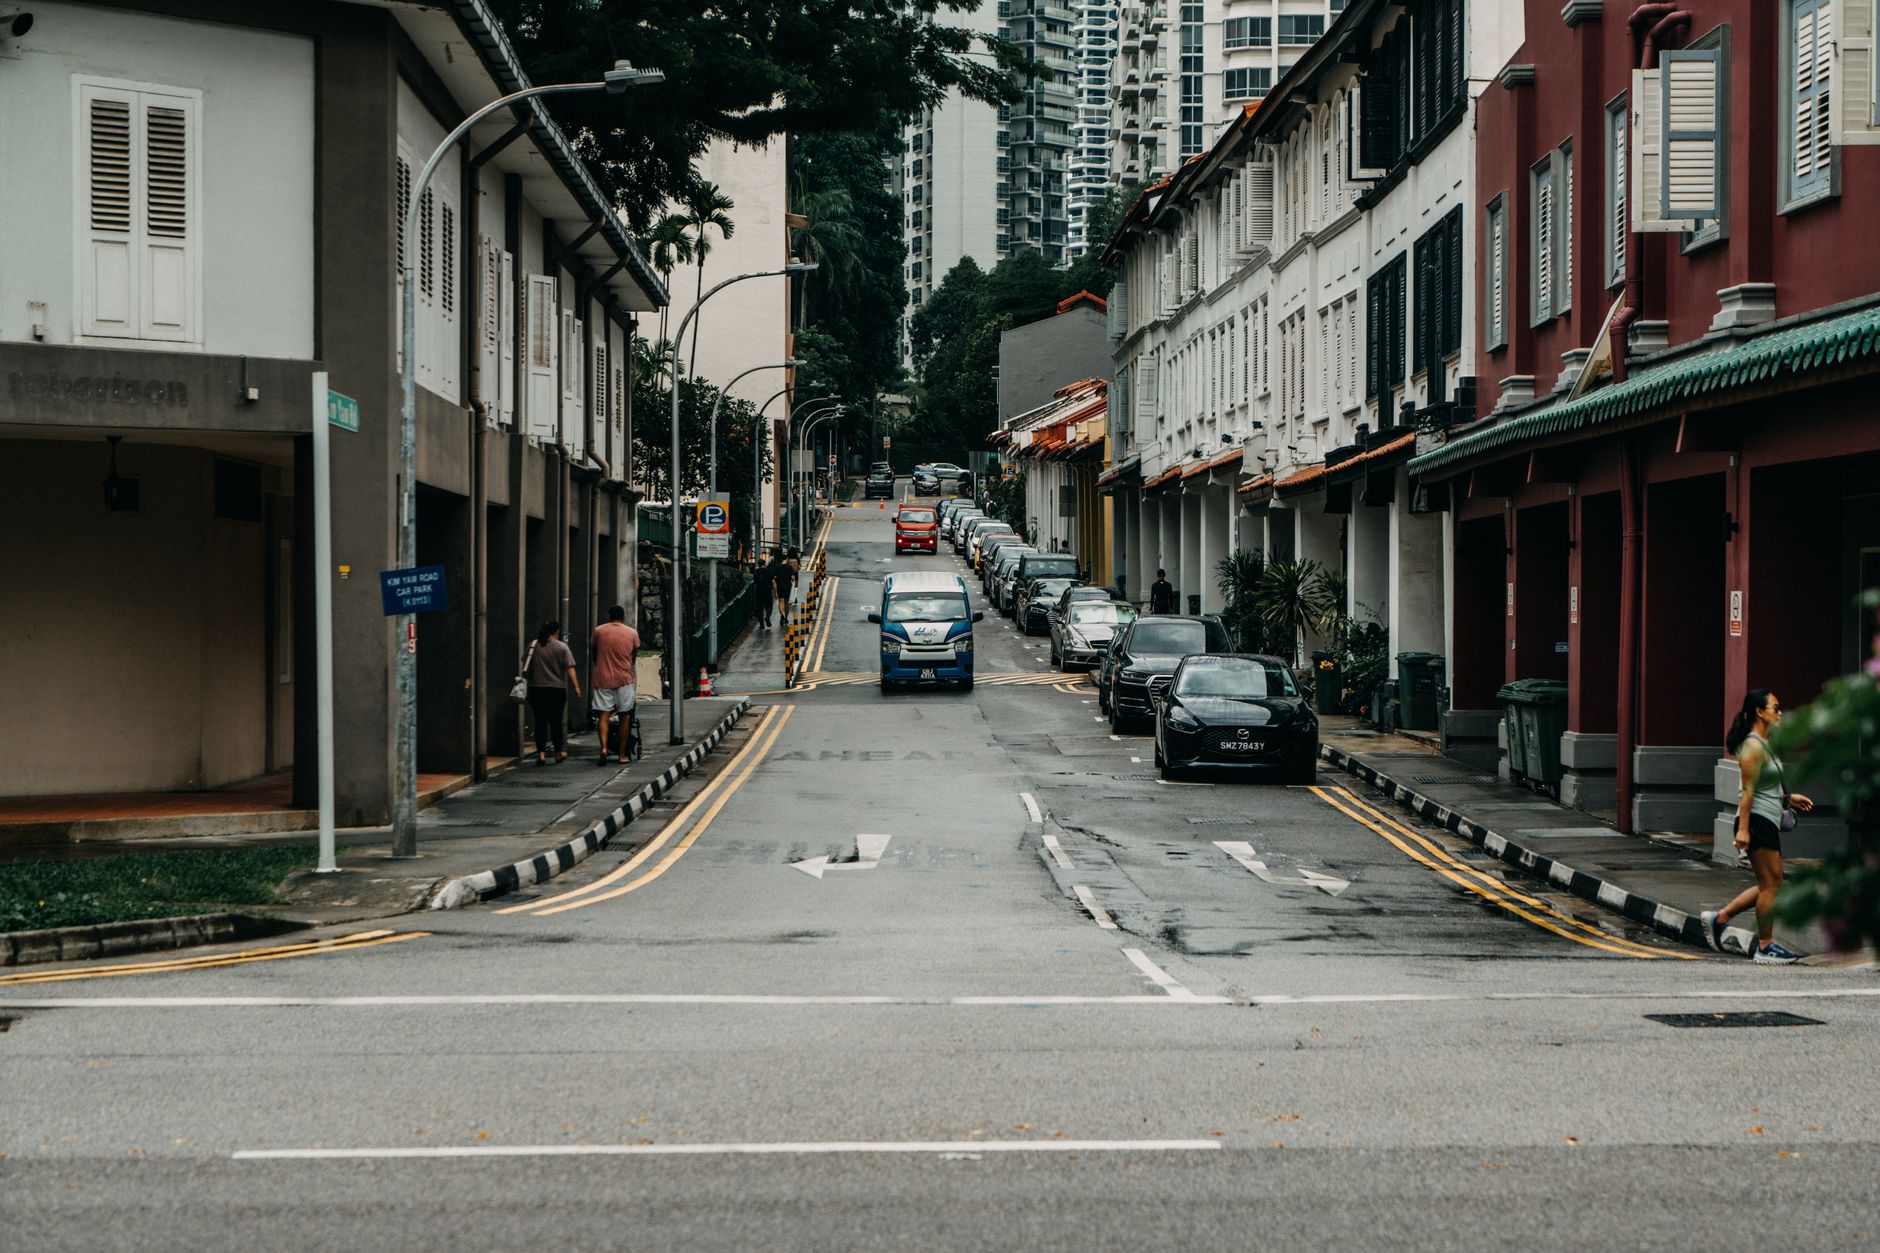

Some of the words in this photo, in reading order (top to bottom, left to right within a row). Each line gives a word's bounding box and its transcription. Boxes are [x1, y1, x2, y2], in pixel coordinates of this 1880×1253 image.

[419, 572, 440, 582] ROAD
[396, 587, 411, 597] CAR
[413, 584, 433, 594] PARK
